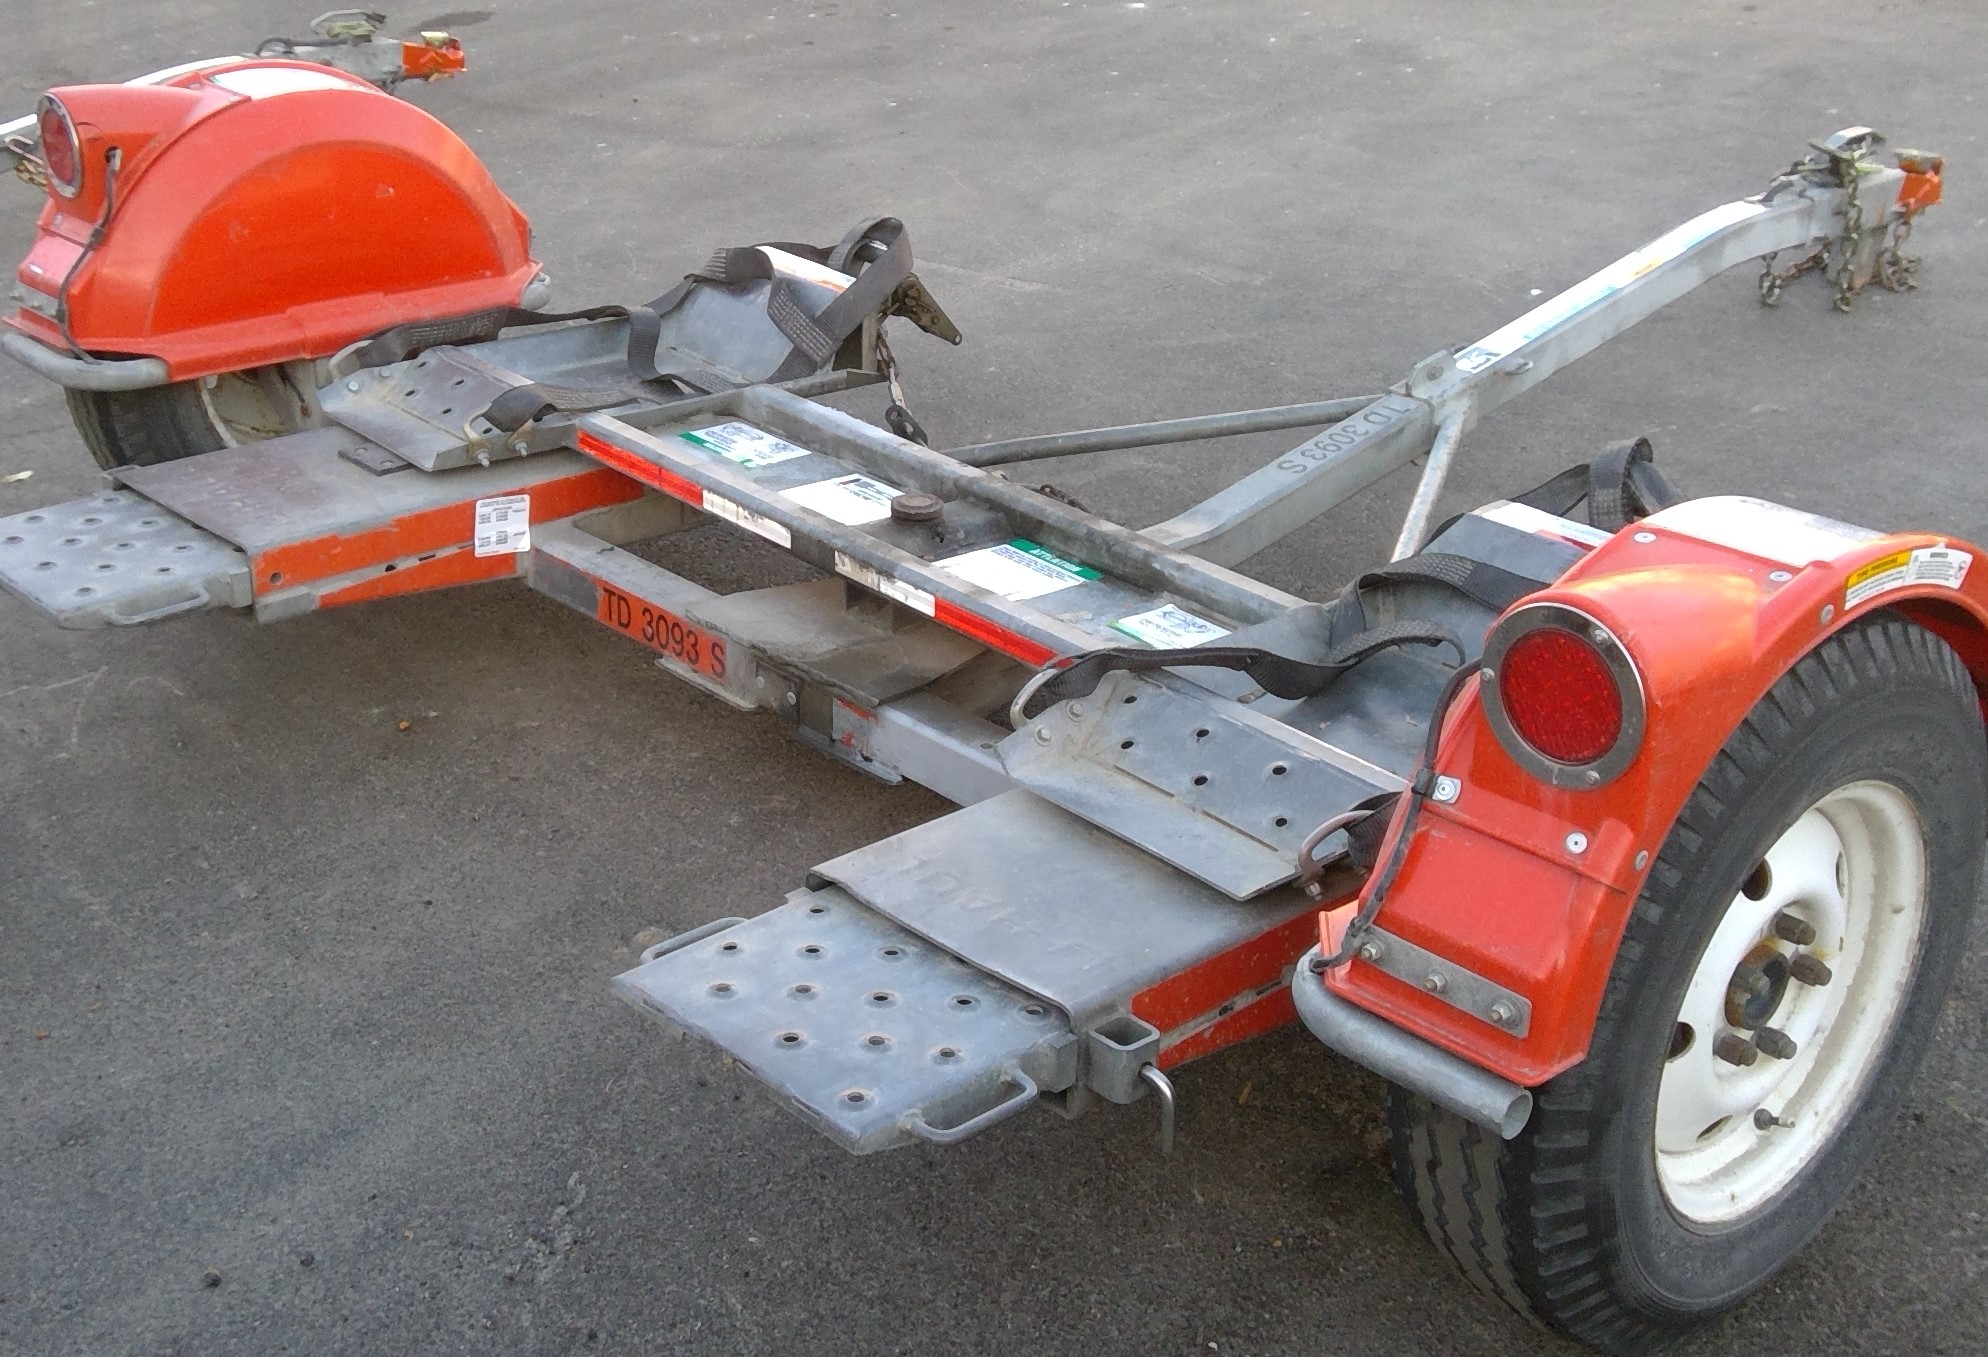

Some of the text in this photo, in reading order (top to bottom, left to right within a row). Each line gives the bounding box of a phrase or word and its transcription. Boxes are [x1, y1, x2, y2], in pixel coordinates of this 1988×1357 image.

[1300, 424, 1370, 461] 3093
[1277, 459, 1308, 474] S
[603, 587, 726, 678] TD 3093 S
